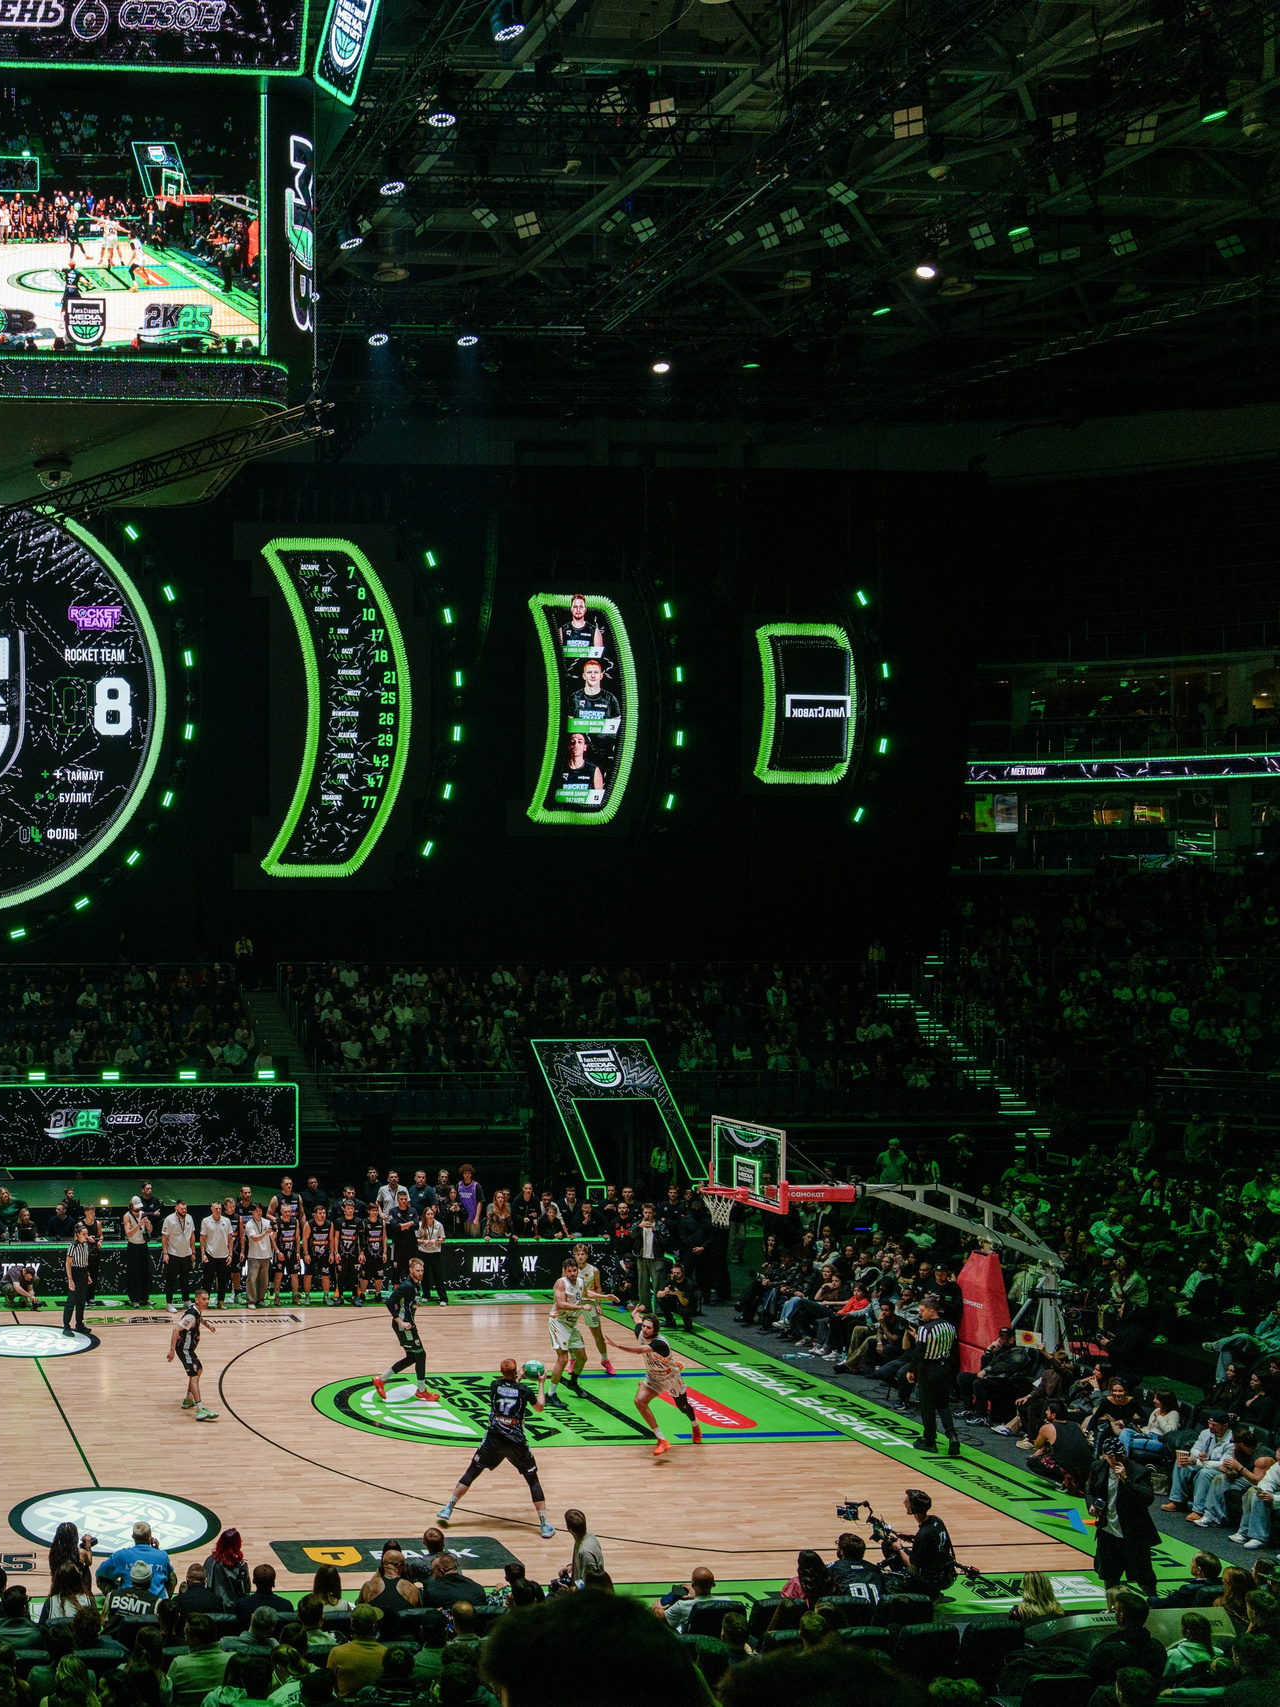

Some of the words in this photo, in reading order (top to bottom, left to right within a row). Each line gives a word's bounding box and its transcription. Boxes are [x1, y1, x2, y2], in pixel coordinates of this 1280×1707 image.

[71, 0, 108, 40] 6
[119, 0, 227, 31] СЕЗОН
[145, 303, 213, 333] 2K25
[347, 566, 355, 579] 7
[357, 587, 366, 600] 8
[70, 606, 120, 619] ROCKET
[362, 608, 376, 621] 10
[77, 617, 112, 629] TEAM
[371, 629, 384, 642] 17
[65, 649, 98, 662] ROCKET
[100, 649, 125, 662] TEAM
[374, 650, 388, 663] 18
[383, 671, 396, 684] 21
[380, 692, 396, 705] 25
[379, 712, 394, 725] 26
[377, 734, 393, 747] 29
[373, 754, 389, 767] 42
[66, 770, 104, 781] ТАЙМАУТ
[1011, 767, 1025, 776] MEN
[1025, 766, 1047, 775] TODAY
[368, 774, 384, 787] 47
[59, 792, 93, 804] БУЛЛИТ
[362, 796, 377, 808] 77
[46, 827, 78, 840] ФОЛЫ
[50, 1109, 102, 1130] 2K25
[107, 1114, 144, 1124] ОСЕНЬ
[144, 1109, 158, 1128] 6
[473, 1256, 499, 1273] MEN
[747, 1362, 820, 1391] ЛИГА
[498, 1398, 517, 1416] 17
[718, 1362, 797, 1396] MEDIA
[789, 1396, 914, 1449] BASKET
[155, 1564, 163, 1572] 71
[849, 1582, 880, 1605] 91
[111, 1595, 151, 1615] BSMT
